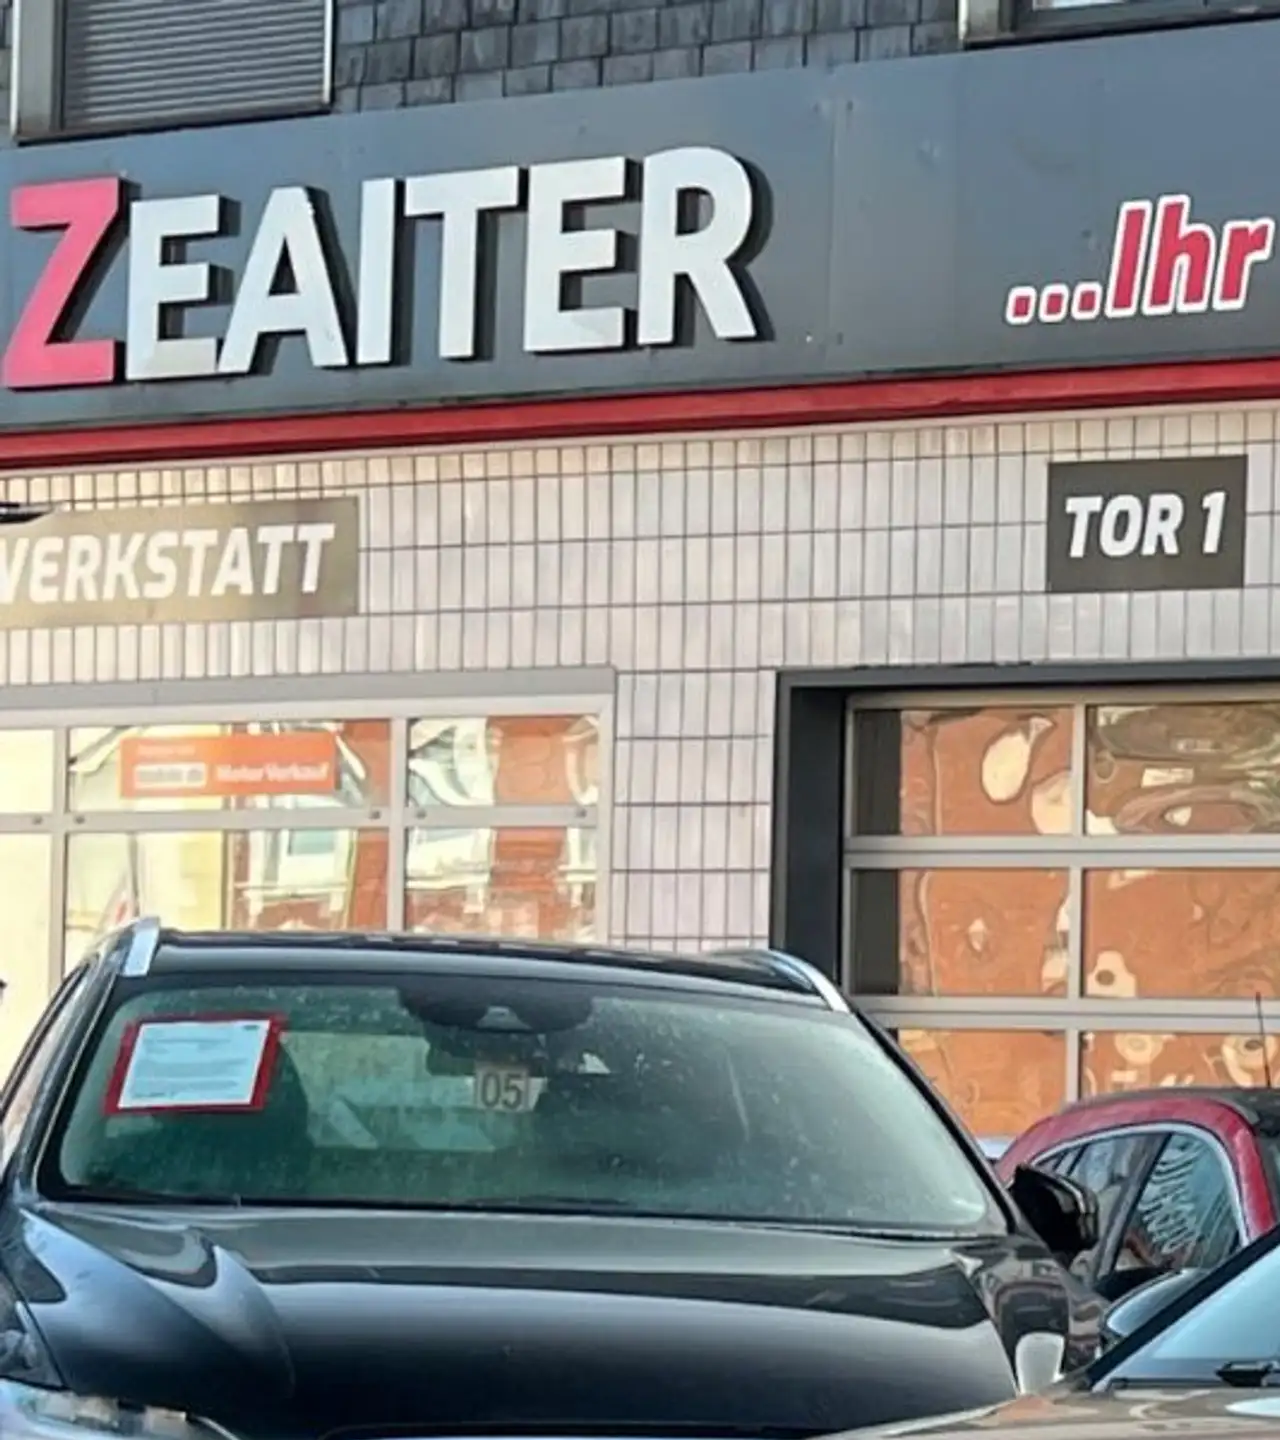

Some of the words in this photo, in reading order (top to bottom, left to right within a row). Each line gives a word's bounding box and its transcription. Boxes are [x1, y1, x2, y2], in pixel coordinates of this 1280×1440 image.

[5, 146, 757, 388] ZEAITER
[1065, 493, 1183, 558] TOR
[1201, 491, 1226, 554] 1
